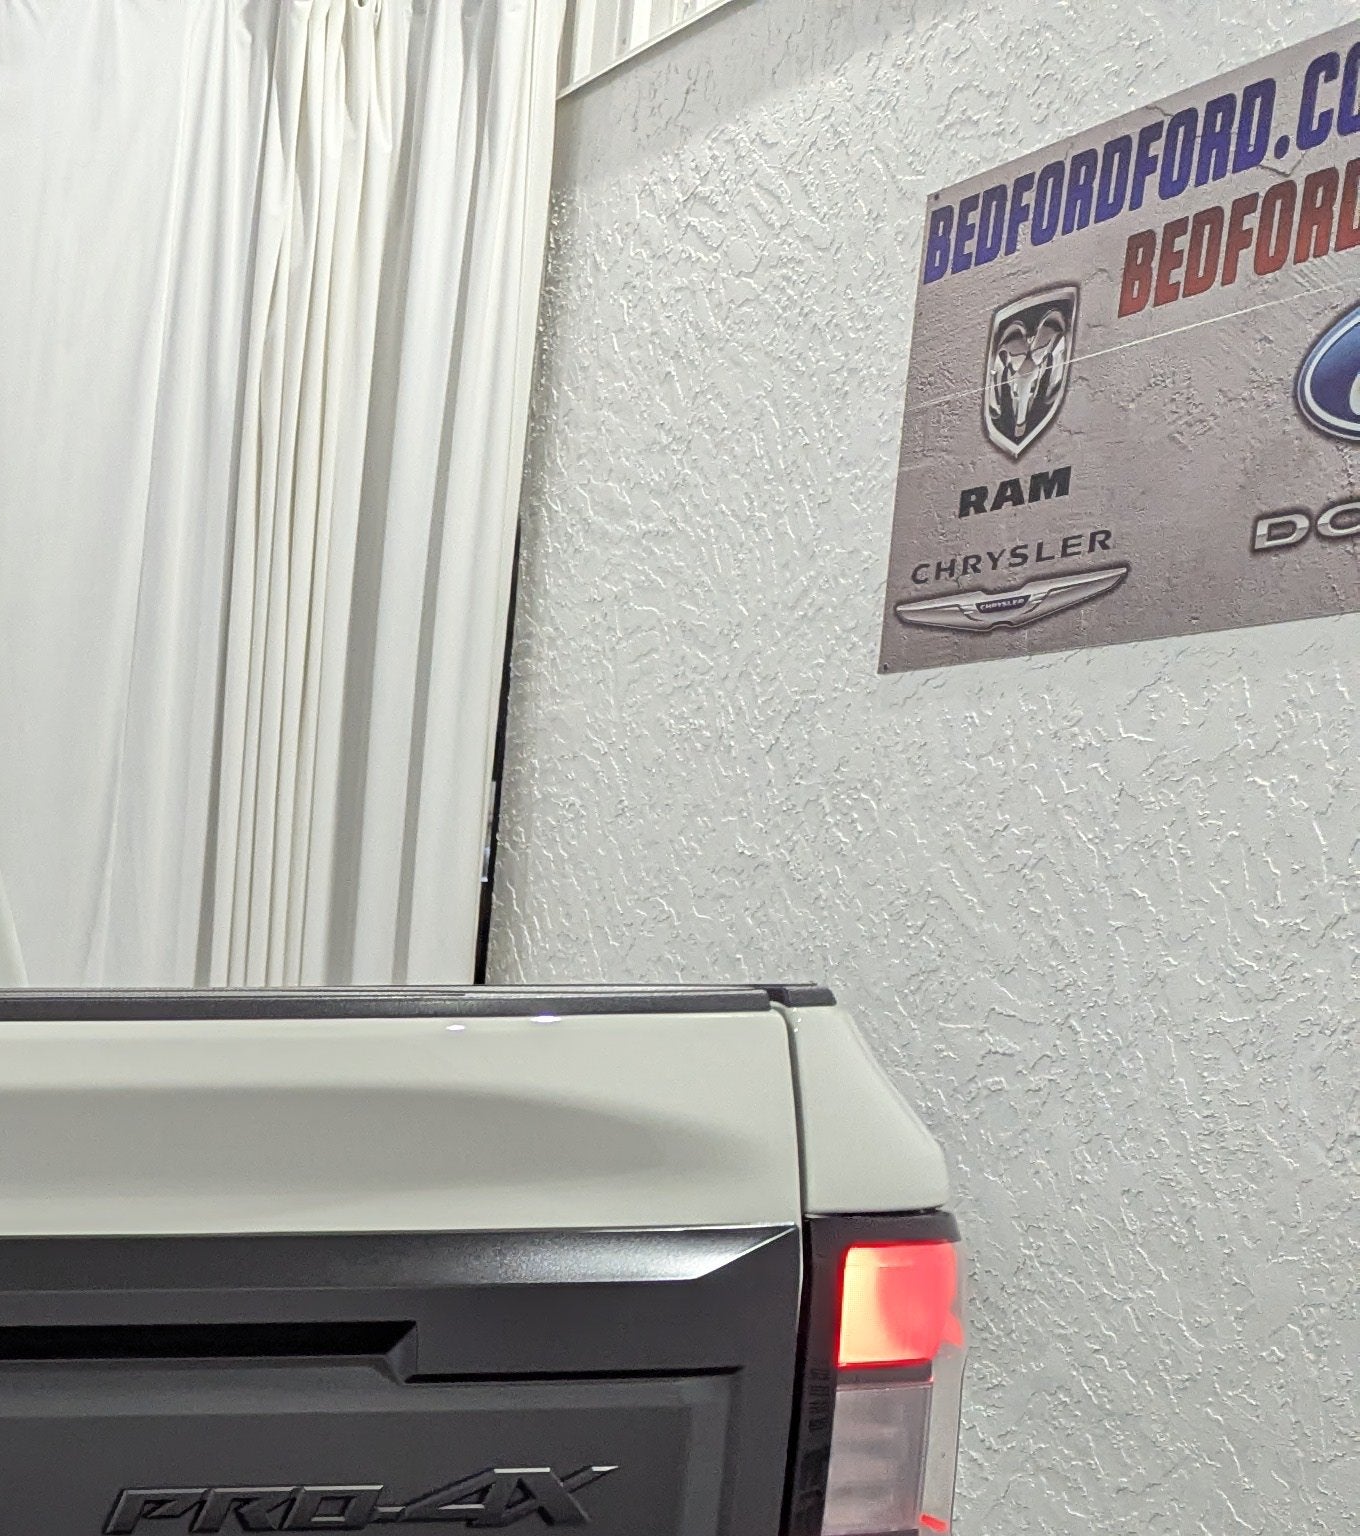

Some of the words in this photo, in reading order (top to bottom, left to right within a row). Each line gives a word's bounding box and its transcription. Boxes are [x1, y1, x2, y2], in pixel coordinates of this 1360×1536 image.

[957, 466, 1072, 518] RAM
[911, 529, 1113, 585] CHRYSLER
[103, 1465, 618, 1536] PRO-4X
